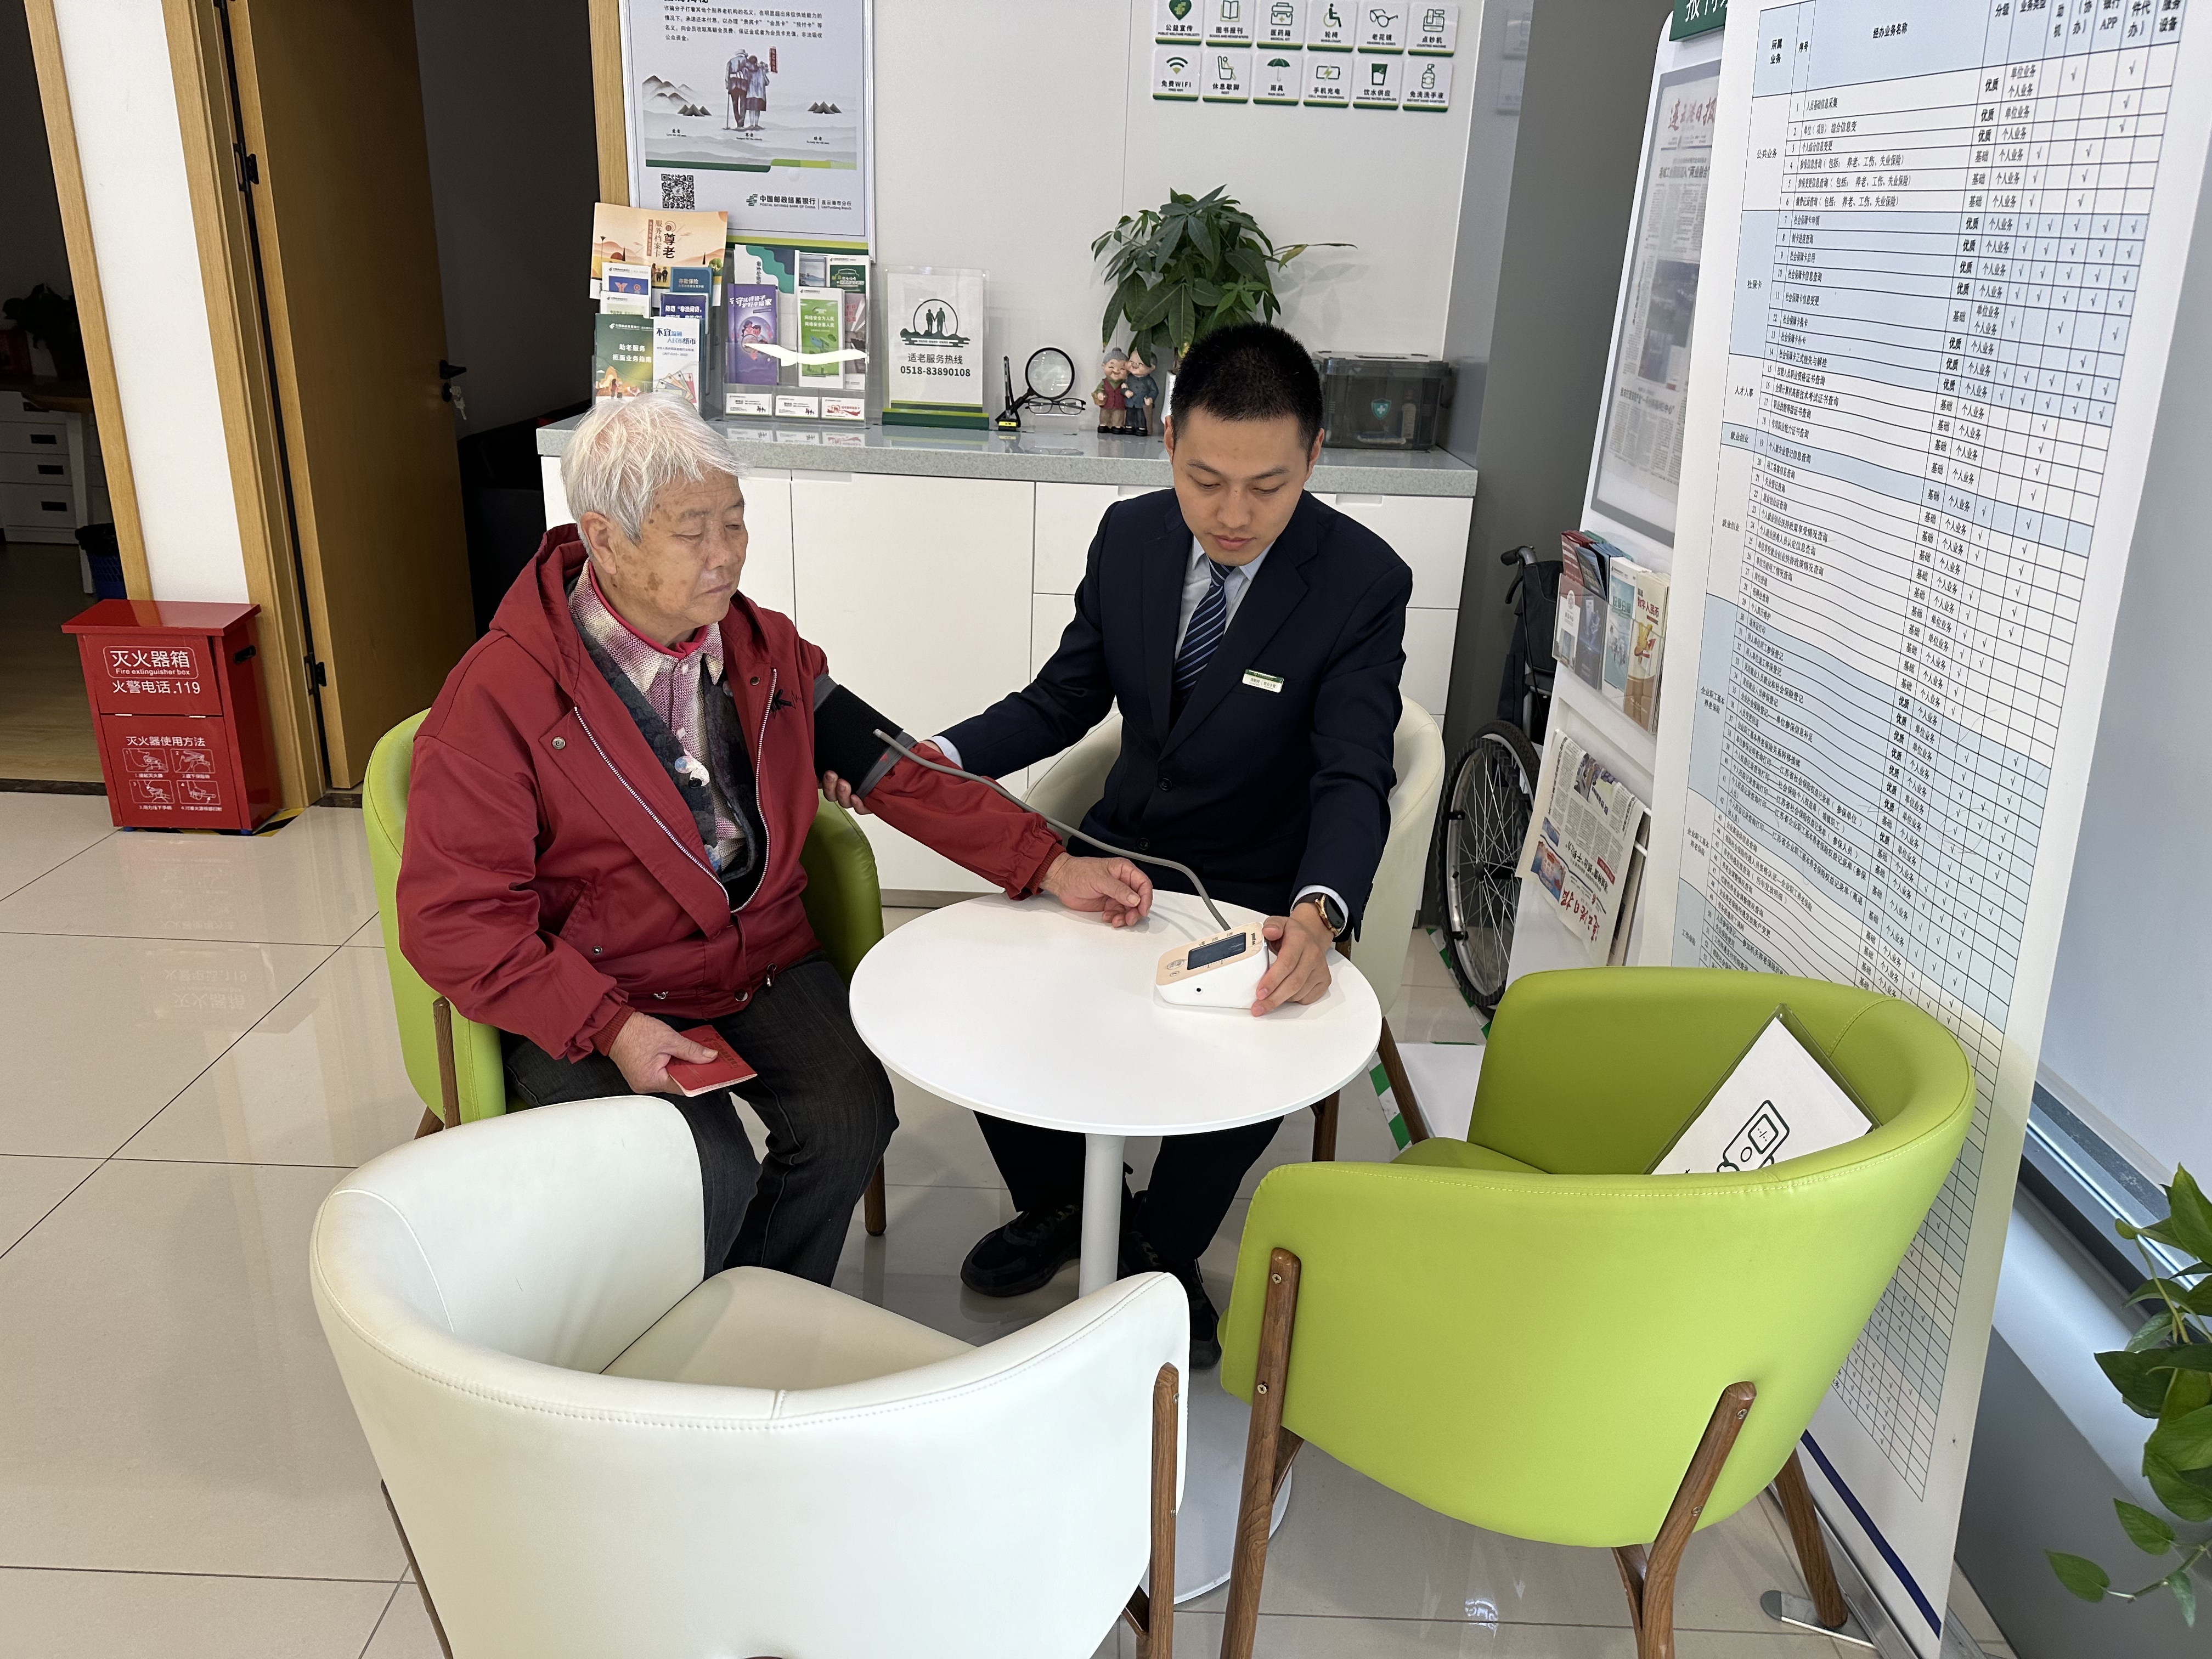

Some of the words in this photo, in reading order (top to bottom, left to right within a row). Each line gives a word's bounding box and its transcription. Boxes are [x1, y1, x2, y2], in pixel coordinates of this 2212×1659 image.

[2100, 16, 2118, 31] APP
[2159, 16, 2177, 32] 设备
[1872, 22, 1908, 39] 经办业务名称
[1771, 38, 1783, 50] 所属
[1798, 41, 1809, 53] 序号
[1770, 54, 1781, 64] 业务
[2010, 65, 2036, 80] 单位业务
[1985, 78, 1999, 92] 优质
[2008, 83, 2033, 99] 个人业务
[1980, 108, 1994, 122] 优质
[2005, 106, 2030, 120] 单位业务
[1793, 127, 1797, 136] 2
[1978, 128, 1991, 143] 优质
[2002, 126, 2027, 141] 个人业务
[1802, 140, 1833, 153] 个人综合信息变更
[1757, 148, 1778, 160] 公共业务
[1975, 150, 1989, 163] 基础
[1999, 149, 2023, 162] 个人业务
[1790, 161, 1793, 170] 4
[1788, 179, 1791, 188] 5
[1972, 172, 1985, 185] 基础
[1995, 171, 2019, 185] 个人业务
[759, 195, 816, 205] 中国邮政储蓄银行
[1786, 197, 1789, 206] 6
[1968, 195, 1983, 208] 基础
[1992, 194, 2016, 208] 个人业务
[1794, 215, 1820, 226] 社会保障卡申领
[1966, 217, 1979, 230] 优质
[1989, 217, 2013, 231] 个人业务
[1792, 233, 1814, 244] 制卡进度查询
[663, 233, 675, 258] 尊老
[1962, 239, 1976, 252] 优质
[1986, 240, 2010, 254] 个人业务
[1780, 251, 1783, 259] 9
[1790, 251, 1815, 263] 社会保障卡启用
[1778, 269, 1782, 277] 10
[1788, 269, 1822, 282] 社会保障卡信息查询
[1747, 279, 1762, 290] 社保卡
[1786, 292, 1819, 306] 社会保障卡信息变更
[1773, 313, 1777, 322] 12
[1953, 310, 1966, 323] 基础
[1976, 304, 2000, 319] 单位业务
[1783, 314, 1808, 328] 社会保障卡换卡
[1974, 320, 1997, 336] 个人业务
[1771, 331, 1775, 339] 13
[1781, 331, 1806, 346] 社会保障卡补卡
[619, 343, 645, 352] 助老服务
[1769, 348, 1774, 356] 14
[908, 353, 963, 365] 适老服务热线
[1779, 349, 1827, 368] 社会保障卡正式挂失与解挂
[900, 366, 970, 377] 0518-83890108
[1768, 364, 1771, 373] 15
[1735, 385, 1754, 397] 人才人事
[1765, 381, 1770, 390] 16
[1764, 398, 1768, 406] 17
[1940, 399, 1953, 411] 基础
[1962, 403, 1985, 420] 个人业务
[1762, 416, 1766, 425] 18
[1764, 477, 1786, 494] 失业登记查询
[1637, 596, 1659, 618] 数字人民币
[1931, 614, 1952, 633] 单位业务
[110, 650, 190, 668] 灭火器箱
[1701, 686, 1725, 706] 企业职工基本
[1704, 699, 1720, 714] 养老保险
[126, 736, 206, 747] 灭火器使用方法
